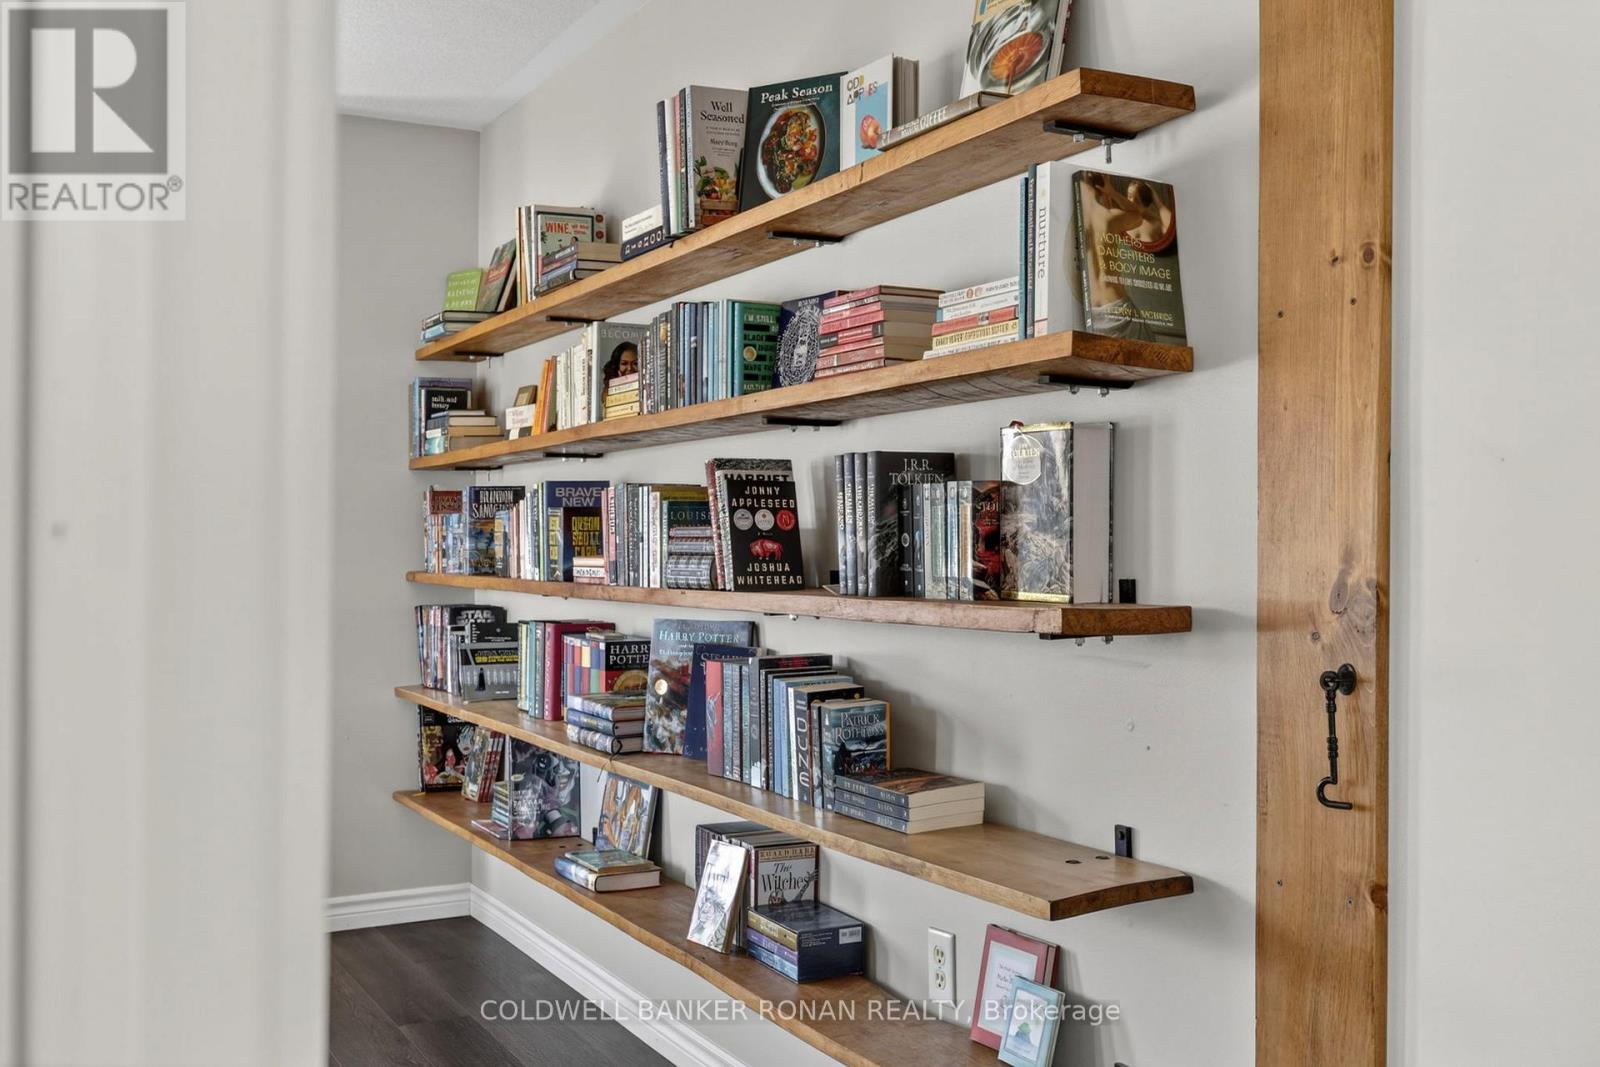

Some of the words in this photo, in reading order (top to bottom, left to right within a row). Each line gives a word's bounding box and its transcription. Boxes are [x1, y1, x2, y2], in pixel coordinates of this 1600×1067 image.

[760, 89, 788, 103] Peak
[792, 83, 833, 99] Season
[710, 101, 733, 112] Well
[700, 111, 745, 124] Seasoned
[1037, 206, 1048, 280] nurture
[1097, 245, 1156, 264] DAUGHTERS
[1109, 259, 1138, 274] BODY
[1139, 265, 1172, 280] IMAGE
[903, 457, 933, 471] J.R.R.
[889, 472, 944, 485] TOLKIEN
[479, 490, 514, 503] BRANDON
[555, 486, 602, 498] BRAVE
[744, 486, 780, 496] JONNY
[562, 497, 596, 507] NEW
[731, 497, 795, 509] APPLESEED
[747, 562, 791, 573] JOSHUA
[737, 574, 803, 585] WHITEHEAD
[460, 609, 494, 619] STAR
[659, 630, 696, 641] HARRY
[698, 631, 741, 643] POTTER
[609, 644, 649, 655] HARR
[608, 654, 650, 665] POTTE
[840, 710, 881, 728] PATRICK
[773, 861, 793, 874] The
[761, 870, 809, 893] Witches
